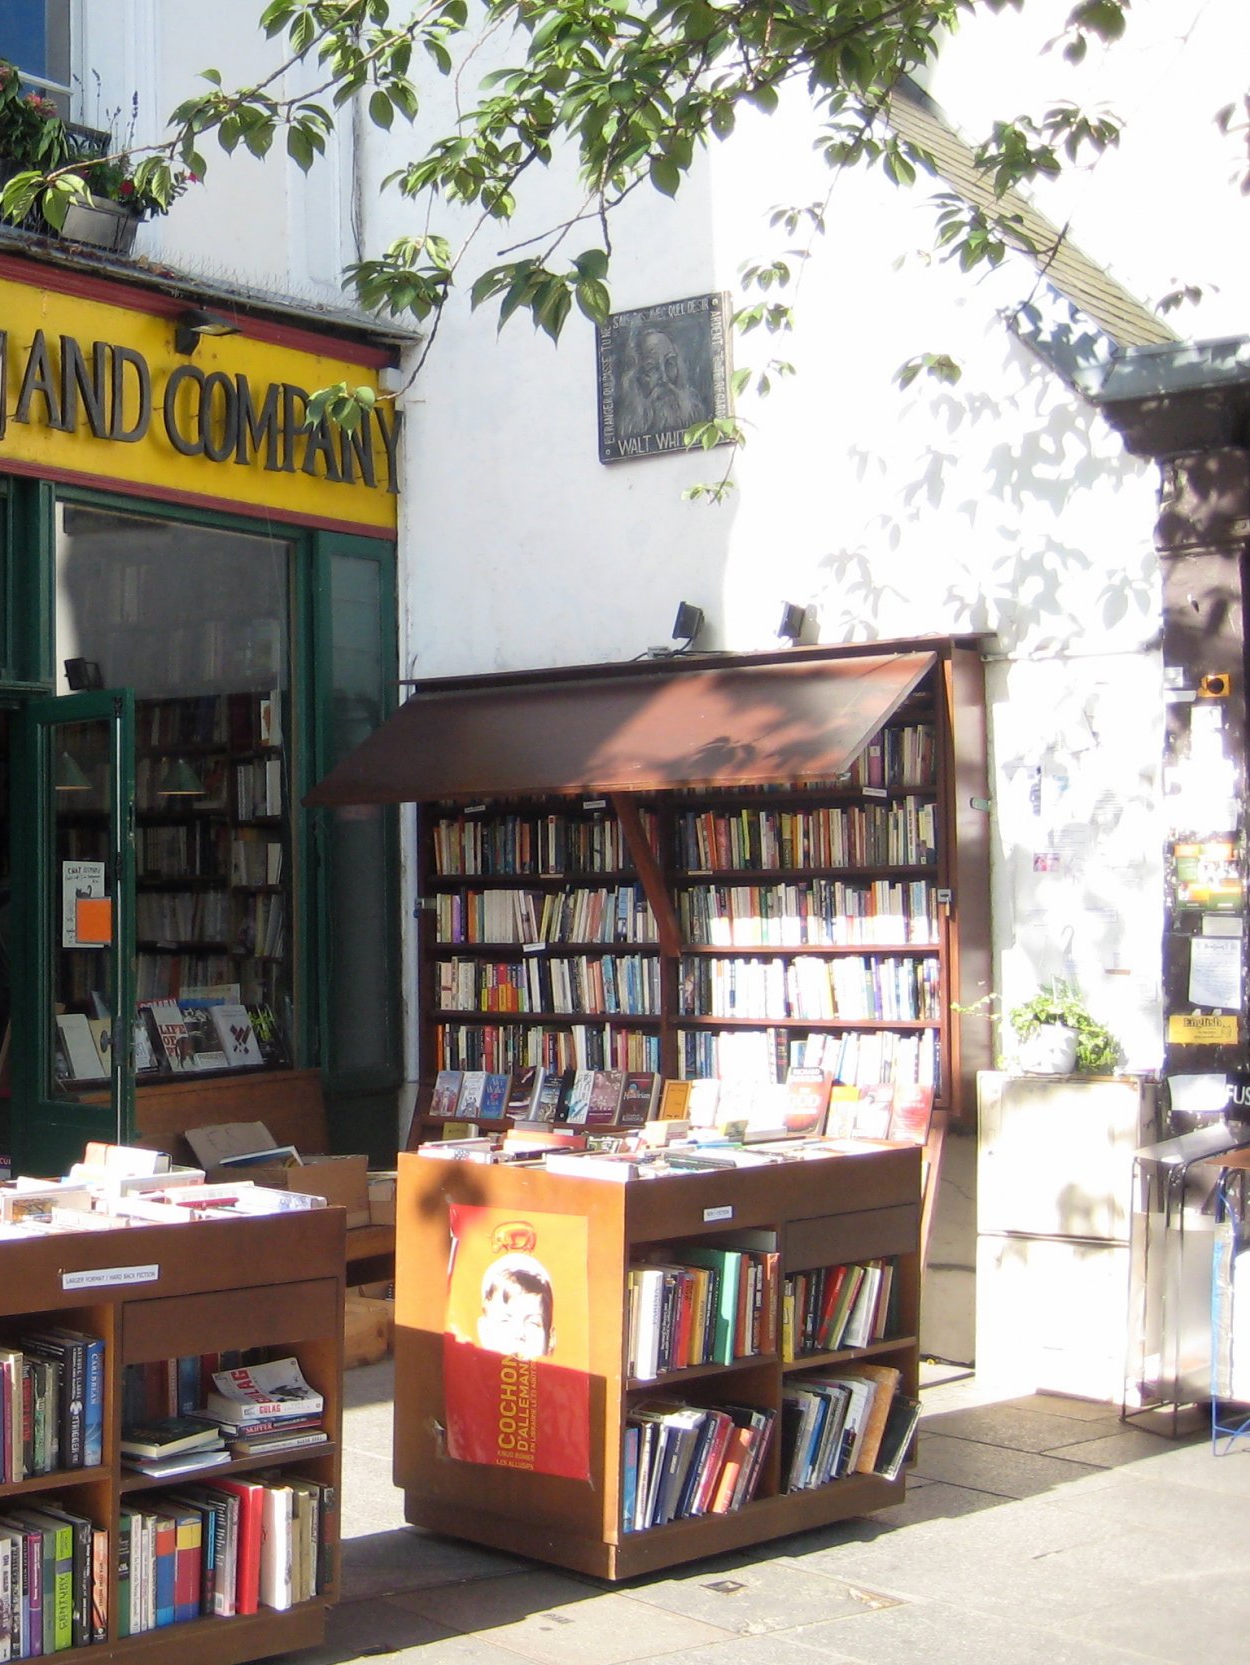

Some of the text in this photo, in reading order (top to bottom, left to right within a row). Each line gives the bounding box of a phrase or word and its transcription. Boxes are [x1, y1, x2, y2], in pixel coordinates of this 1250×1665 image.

[710, 311, 723, 345] ARDENT
[15, 329, 150, 442] AND
[164, 365, 403, 494] COMPANY
[617, 435, 652, 456] WALT
[158, 1024, 188, 1035] LIFE
[1183, 1017, 1222, 1029] English
[163, 1036, 177, 1046] OF
[259, 1404, 281, 1414] GULAG
[71, 1420, 80, 1454] TRIGGER
